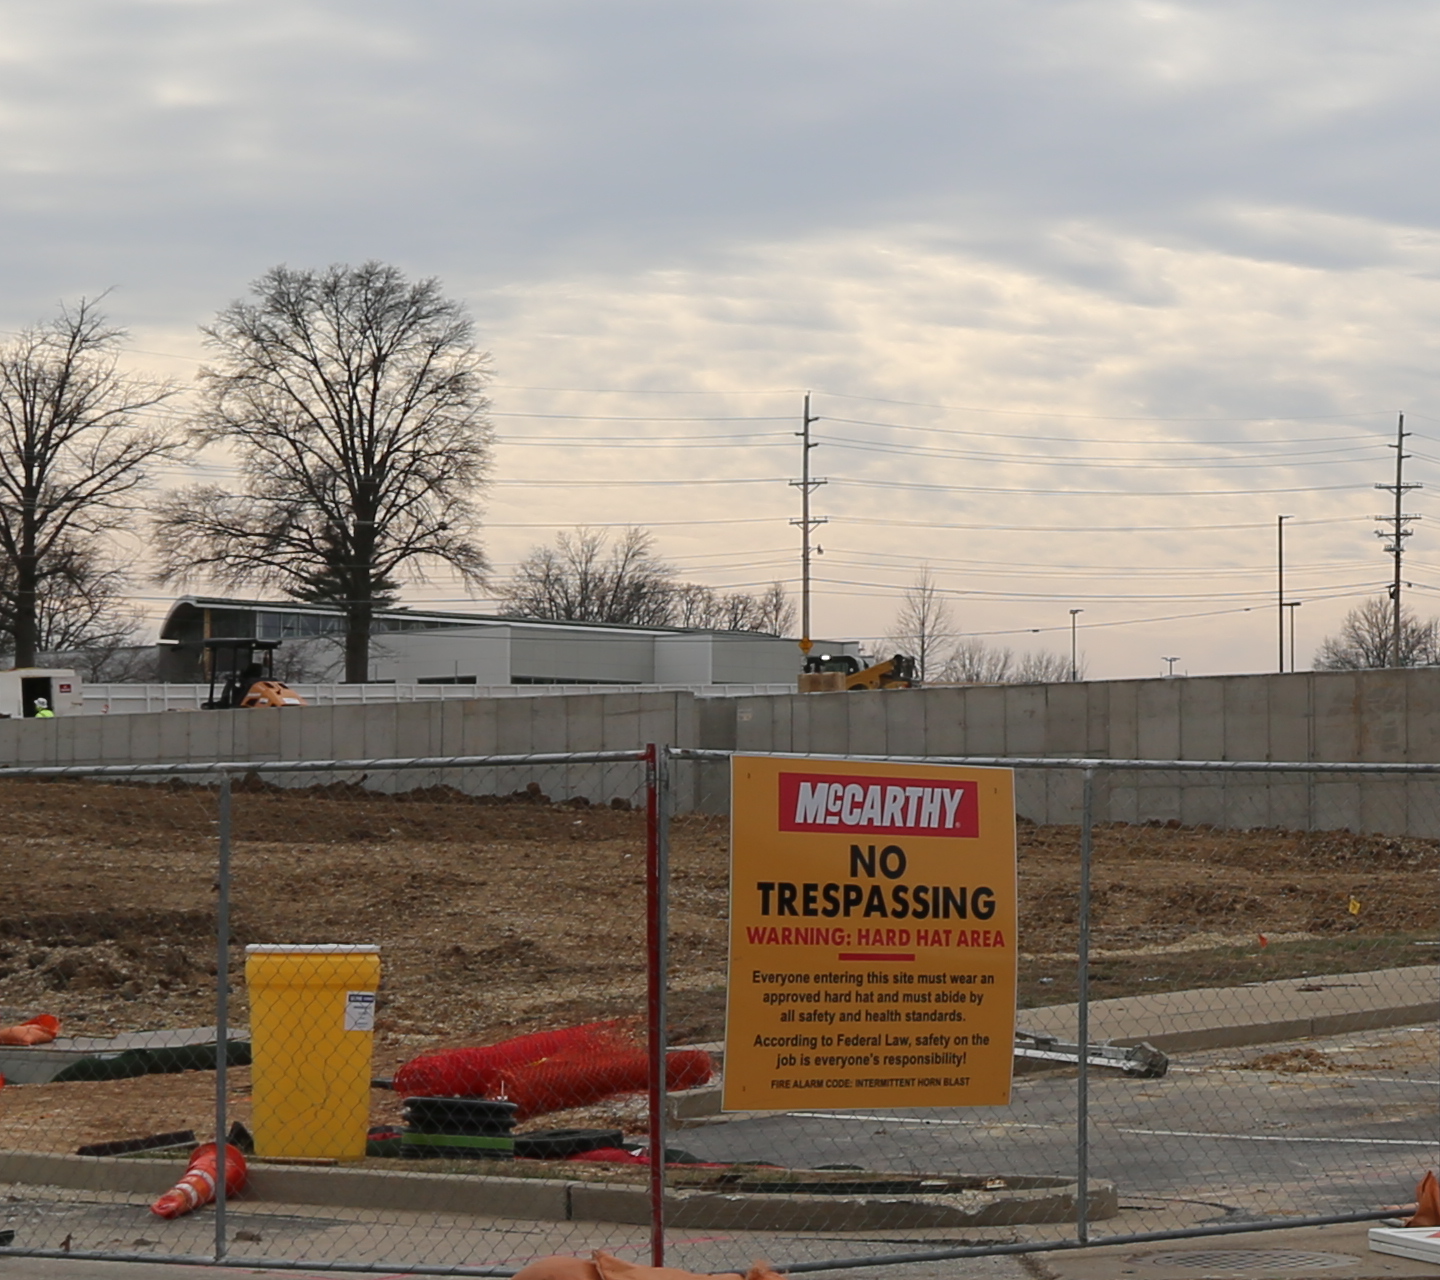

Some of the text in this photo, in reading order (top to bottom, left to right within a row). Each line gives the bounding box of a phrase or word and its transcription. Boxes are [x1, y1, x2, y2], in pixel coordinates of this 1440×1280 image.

[850, 845, 907, 879] NO
[757, 882, 996, 920] TRESPASSING
[746, 926, 1005, 948] WARNING: HARD HAT AREA
[752, 970, 994, 987] Everyone entering this site must wear an
[763, 990, 983, 1006] approved hard hat and must abide by
[780, 1009, 966, 1025] all safety and health standards.
[753, 1033, 990, 1050] According to Federal Law, safety on the
[776, 1051, 966, 1069] job is everyone's responsibility!
[771, 1077, 970, 1089] FIRE ALARM CODE: INTERMITTENT HORN BLAST
